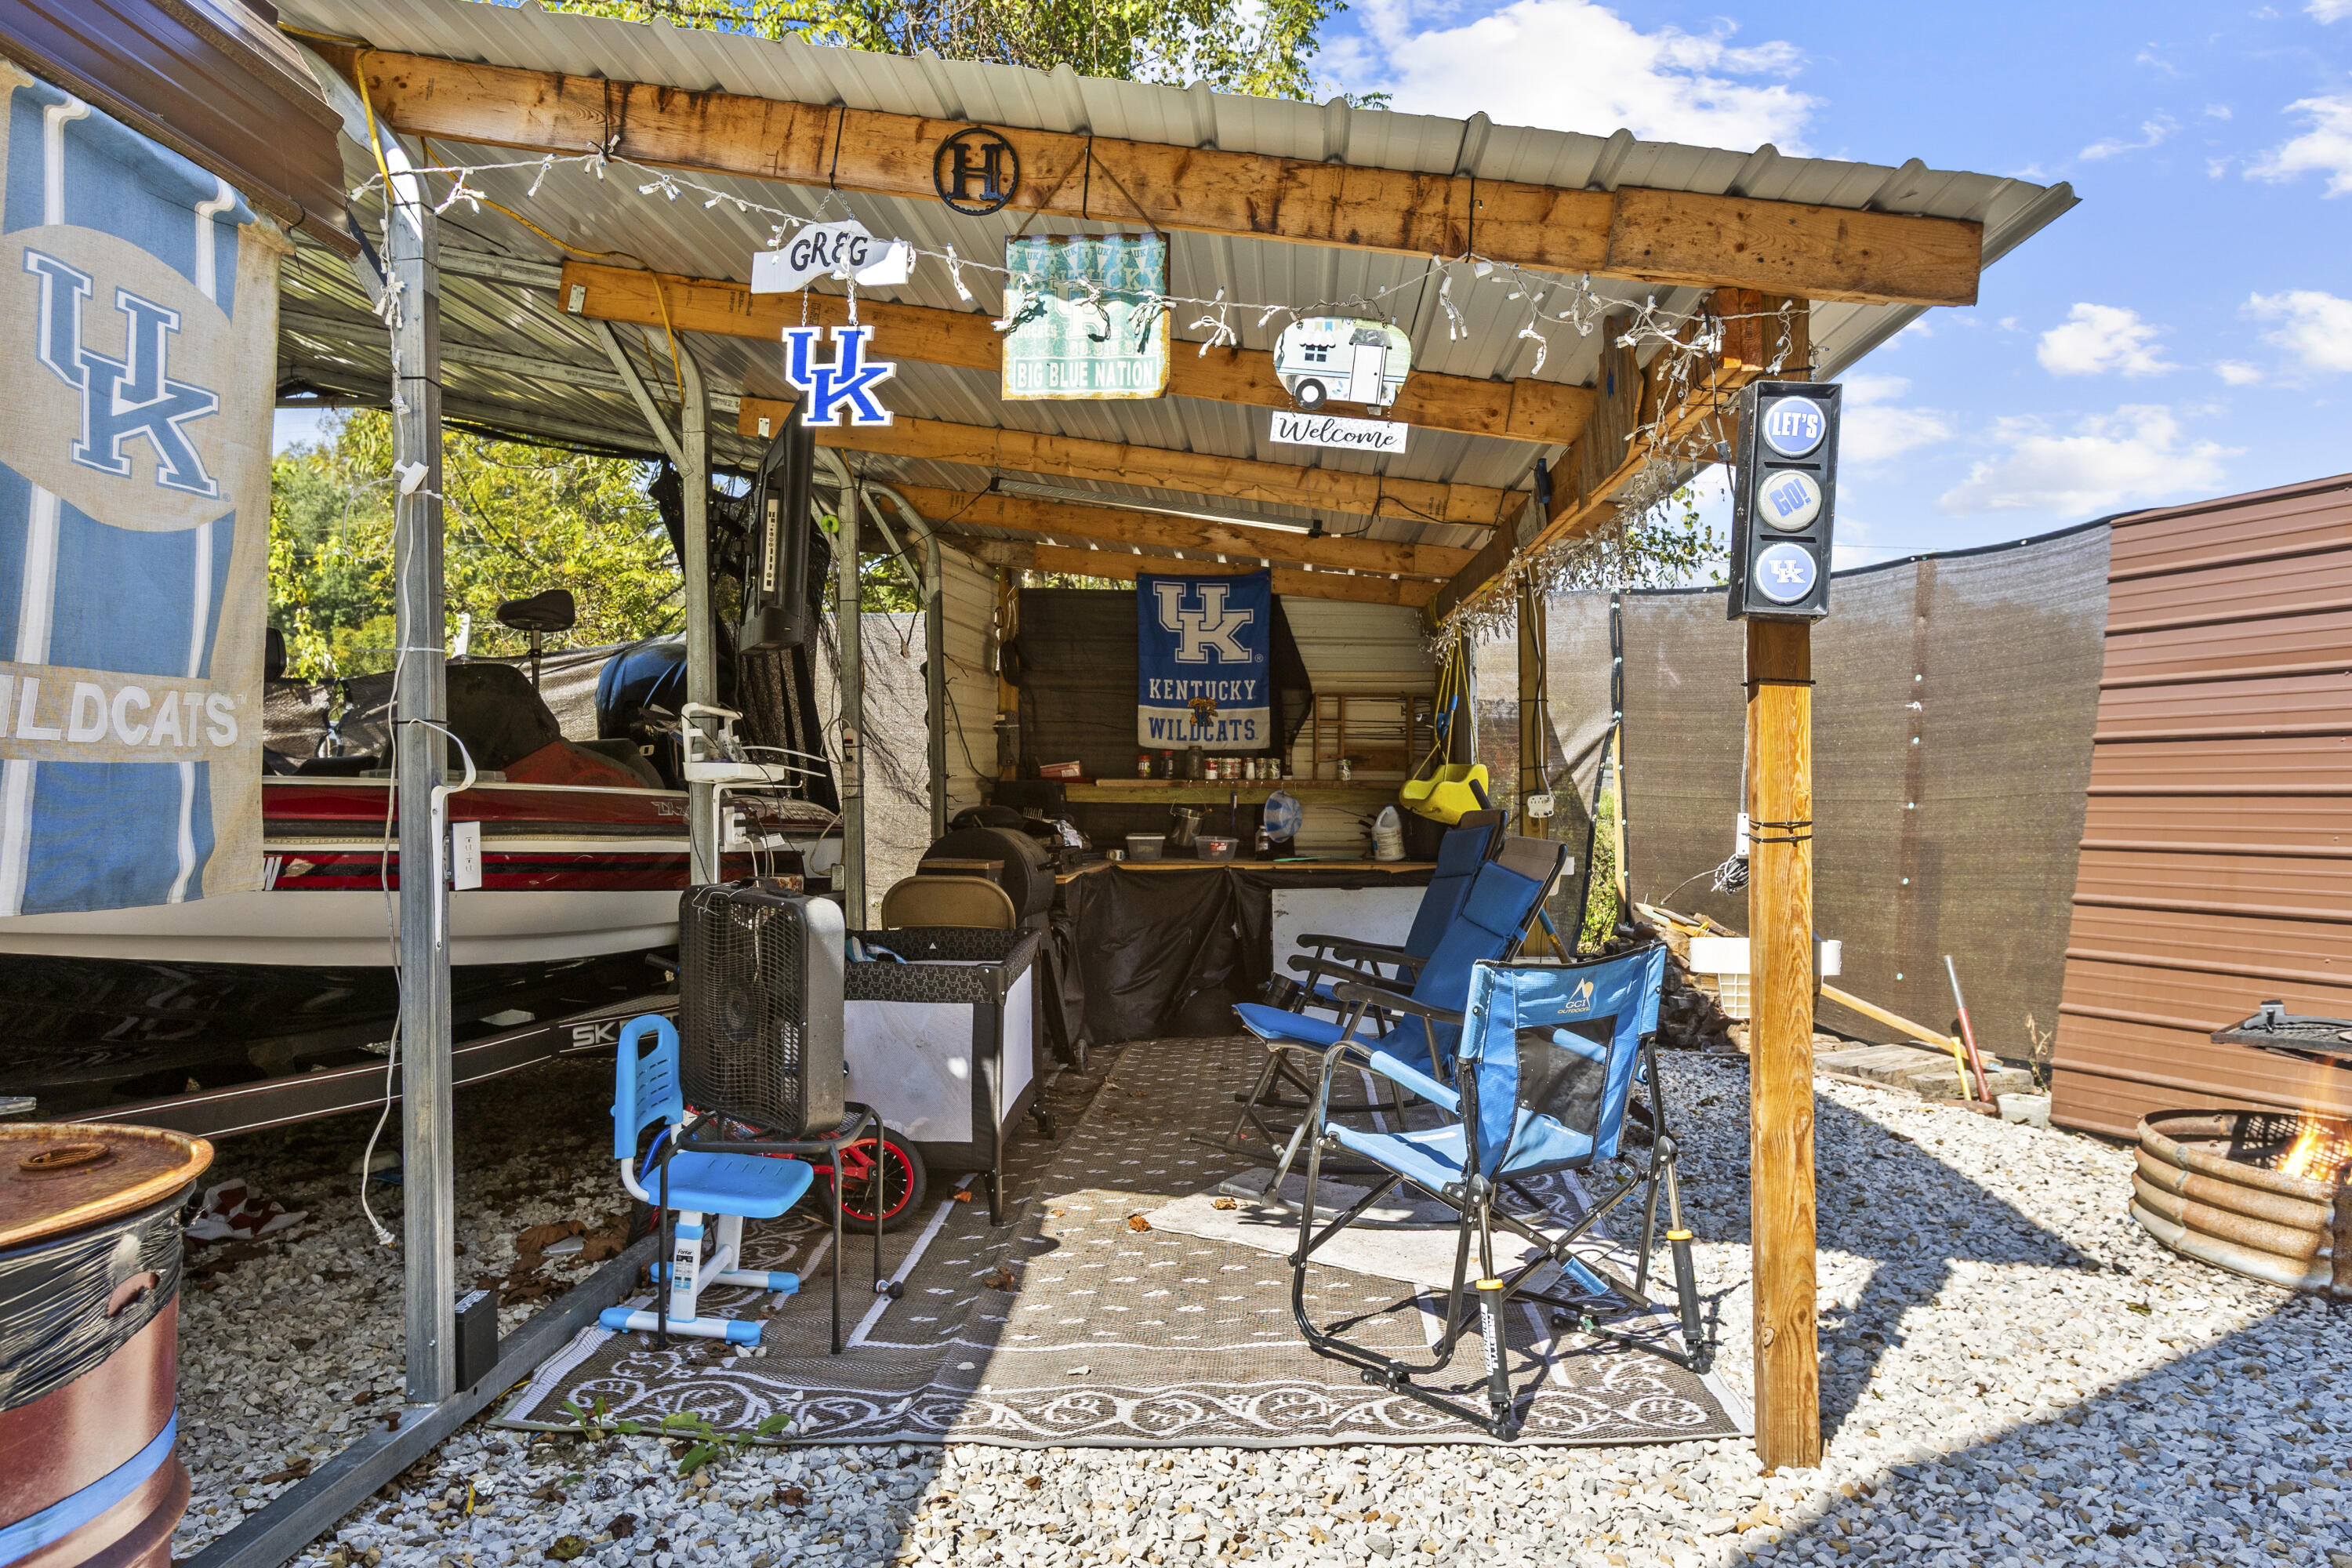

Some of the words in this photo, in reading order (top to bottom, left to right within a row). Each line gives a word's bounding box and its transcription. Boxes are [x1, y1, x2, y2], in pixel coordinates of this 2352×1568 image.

[946, 143, 1005, 201] H
[790, 231, 868, 271] GREG
[1027, 252, 1039, 260] UK
[1064, 248, 1077, 258] UK
[1098, 247, 1109, 256] UK
[1134, 249, 1146, 258] UK
[23, 246, 220, 500] UK
[782, 325, 897, 426] UK
[1018, 362, 1043, 387] BIG
[1049, 361, 1088, 387] BLUE
[1095, 361, 1153, 387] NATION
[1279, 418, 1397, 448] Welcome
[1772, 412, 1819, 439] LET'S
[1769, 477, 1812, 517] GO!
[1769, 559, 1806, 583] UK
[1152, 581, 1254, 664] UK
[1149, 678, 1256, 701] KENTUCKY
[0, 673, 238, 747] ILDCATS
[1149, 717, 1255, 742] WILDCATS
[1566, 999, 1586, 1009] GCI
